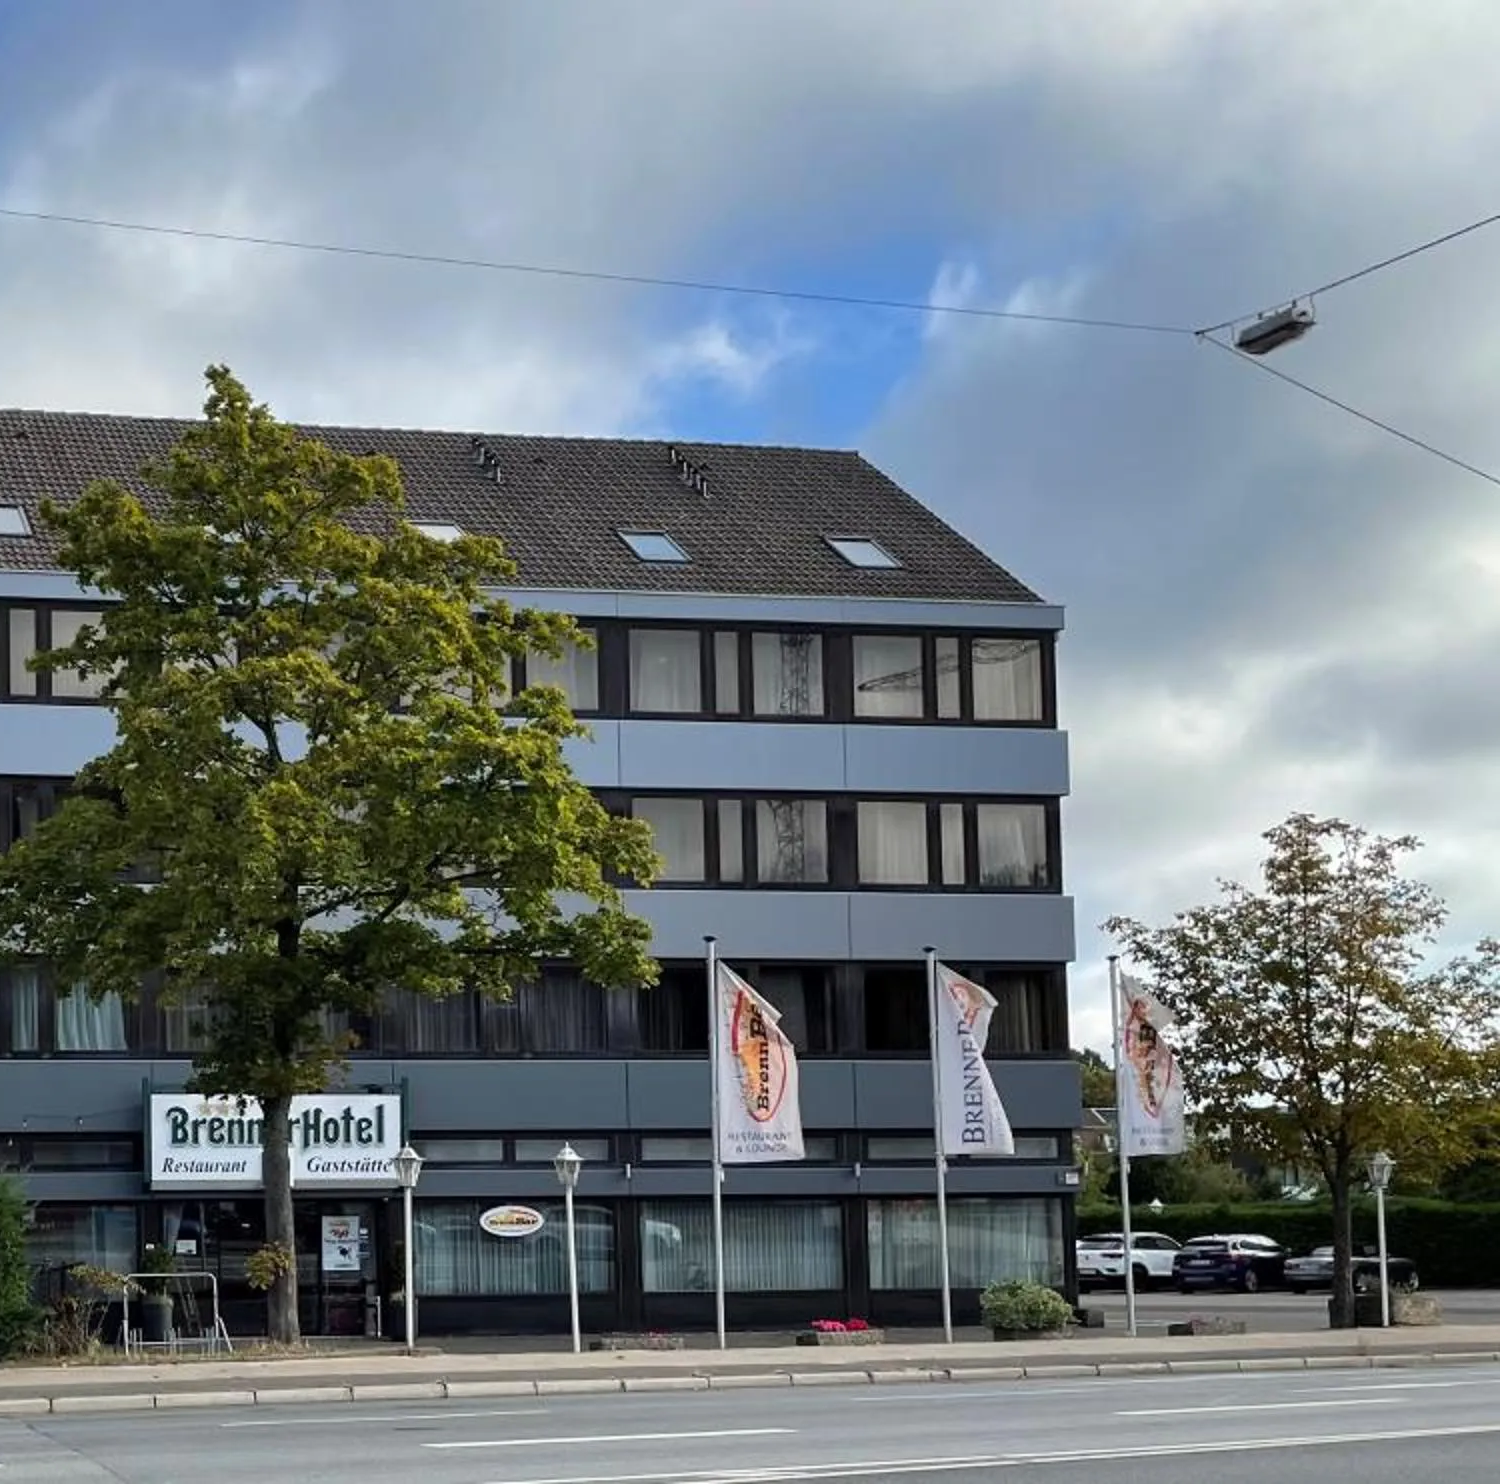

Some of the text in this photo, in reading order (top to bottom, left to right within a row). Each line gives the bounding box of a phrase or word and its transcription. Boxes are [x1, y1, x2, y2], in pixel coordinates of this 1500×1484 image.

[166, 1105, 384, 1149] BrennrHotel
[162, 1156, 393, 1173] Restaurant Gaststätte
